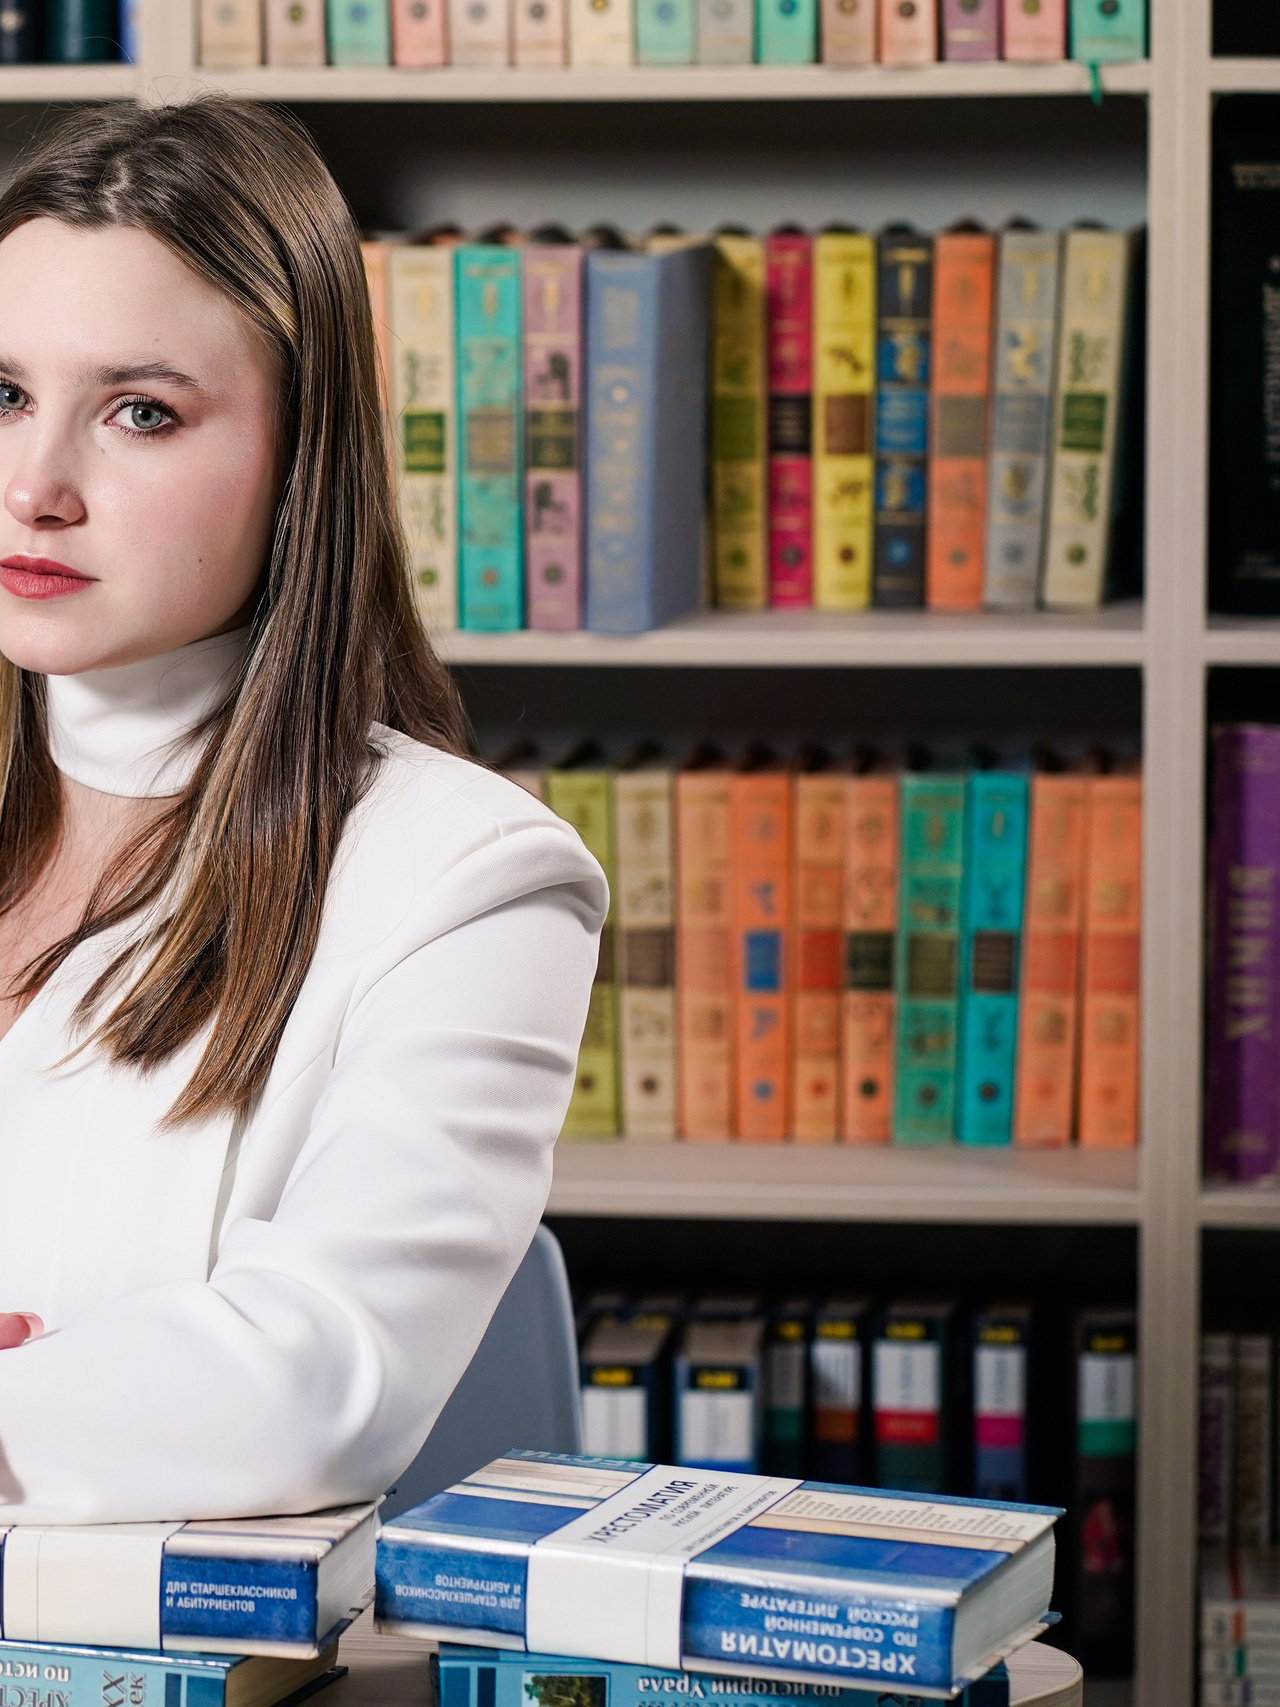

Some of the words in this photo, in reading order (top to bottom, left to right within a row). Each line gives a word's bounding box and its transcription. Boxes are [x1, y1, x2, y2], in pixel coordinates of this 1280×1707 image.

[582, 1480, 699, 1544] ХРЕСТОМАТИЯ
[165, 1581, 188, 1594] ДЛЯ
[190, 1582, 297, 1600] СТАРШЕКЛАССНИКОВ
[434, 1574, 510, 1595] АБИТУРИЕНТОВ
[513, 1583, 521, 1595] И
[165, 1597, 174, 1607] И
[177, 1597, 255, 1612] АБИТУРИЕНТОВ
[394, 1584, 498, 1608] СТАРШЕКЛАССНИКОВ
[499, 1597, 522, 1610] ДЛЯ
[739, 1593, 840, 1619] ЛИТЕРАТУРЕ
[846, 1605, 920, 1629] РУССКОЙ
[763, 1613, 885, 1644] СОВРЕМЕННОЙ
[892, 1630, 918, 1648] ПО
[720, 1631, 917, 1675] ХРЕСТОМАТИЯ
[43, 1665, 71, 1683] по
[637, 1672, 706, 1700] Урала
[710, 1676, 810, 1698] истории
[811, 1681, 842, 1698] по
